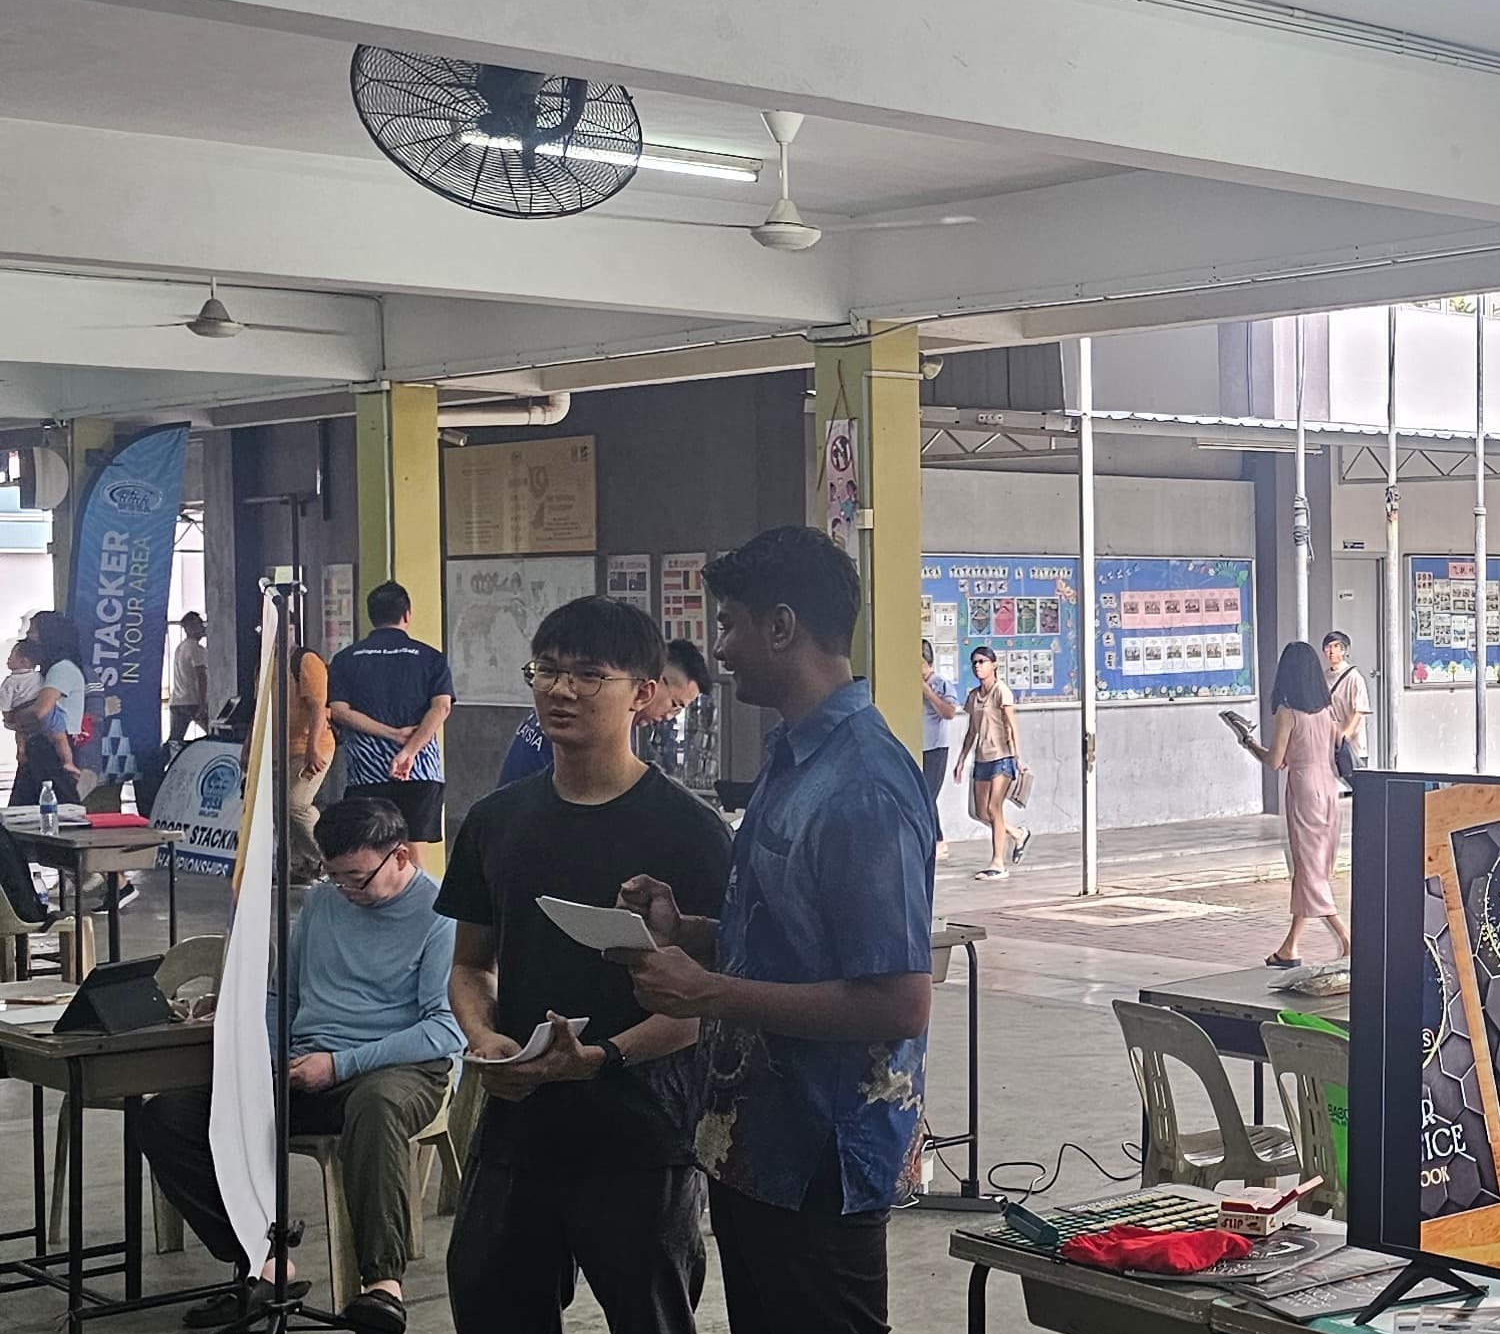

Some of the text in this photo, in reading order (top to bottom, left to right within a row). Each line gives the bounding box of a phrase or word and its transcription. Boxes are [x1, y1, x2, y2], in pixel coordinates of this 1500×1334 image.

[92, 530, 130, 687] STACKER
[120, 534, 152, 684] IN YOUR AREA
[189, 825, 239, 851] STACKIN
